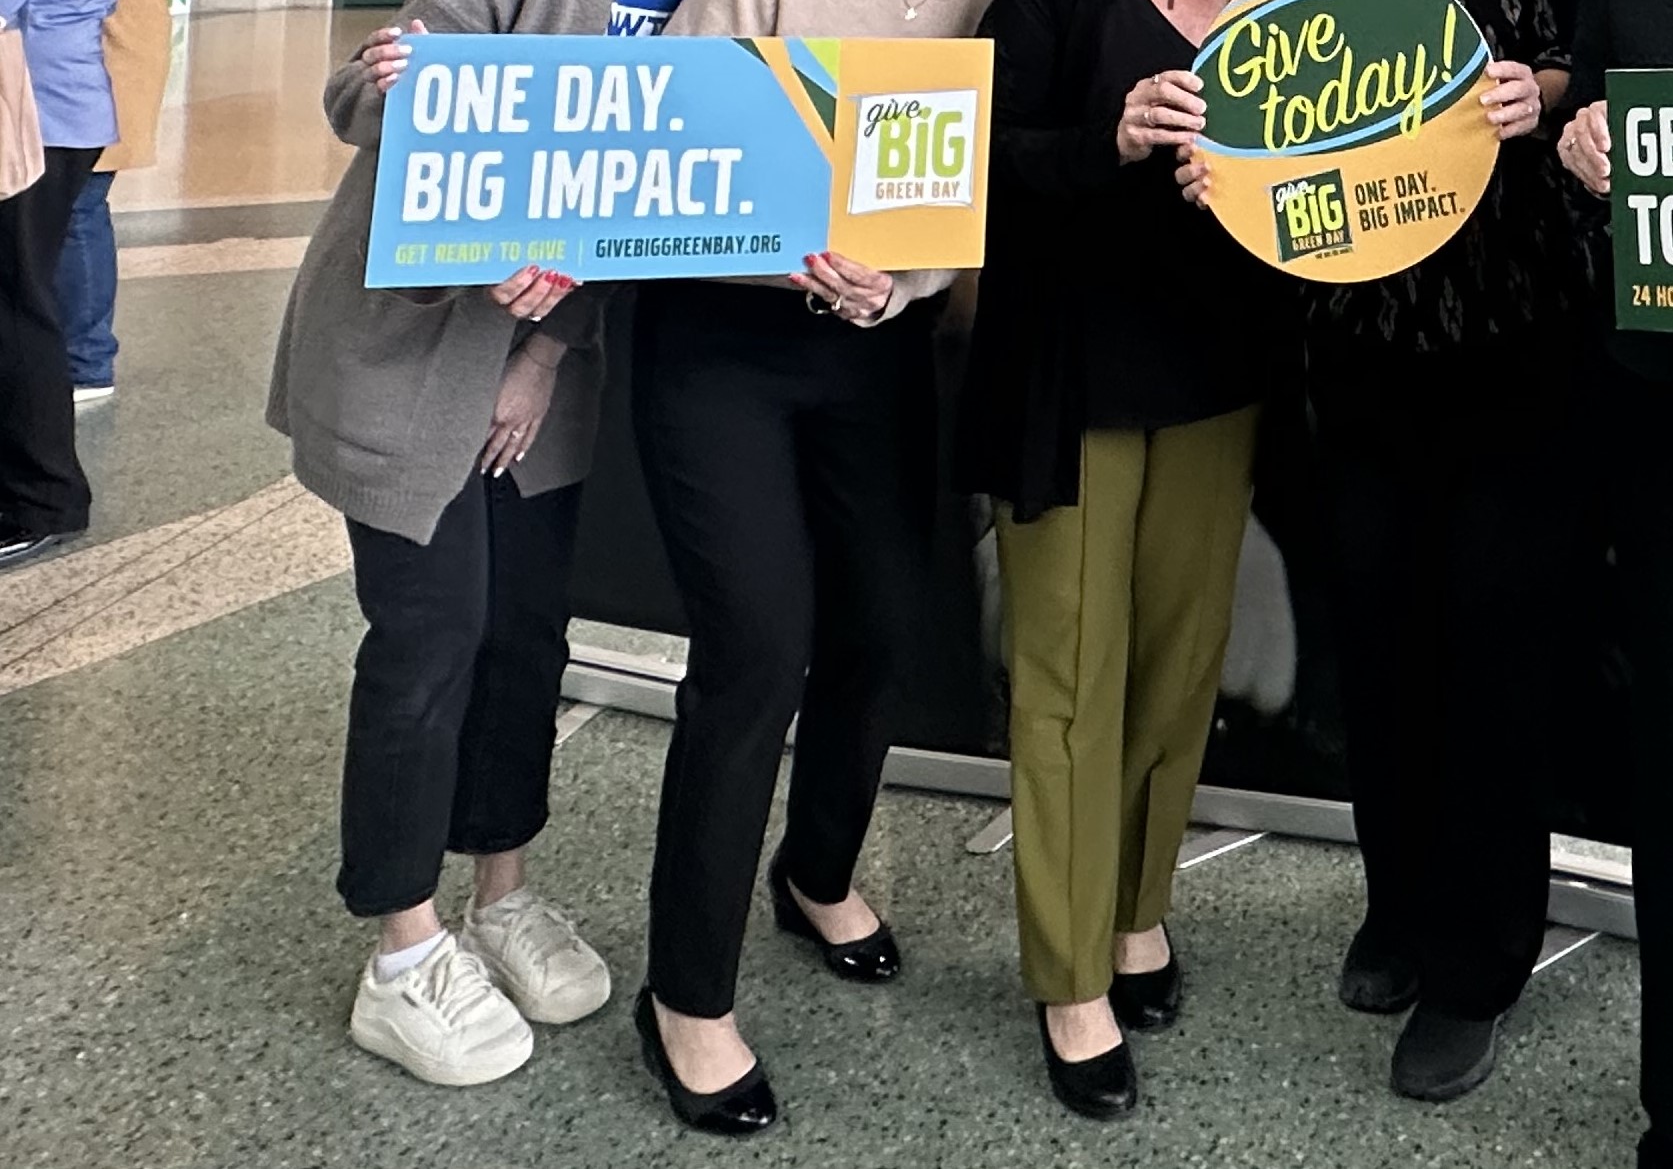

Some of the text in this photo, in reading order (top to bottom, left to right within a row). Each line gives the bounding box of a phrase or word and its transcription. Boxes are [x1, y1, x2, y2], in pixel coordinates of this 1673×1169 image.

[1217, 12, 1346, 98] Give
[1259, 3, 1457, 153] today!
[412, 64, 684, 134] ONE DAY.
[864, 98, 922, 138] give
[402, 148, 753, 222] BIG IMPACT.
[875, 181, 960, 200] GREEN BAY
[1276, 181, 1309, 213] give
[1355, 170, 1437, 207] ONE DAY.
[1359, 191, 1466, 231] BIG IMPACT.
[395, 239, 566, 265] GET READY TO GIVE
[595, 234, 782, 259] GIVEBIGGREENBAY.ORG
[1292, 231, 1345, 251] GREEN BAY
[1632, 285, 1651, 307] 24
